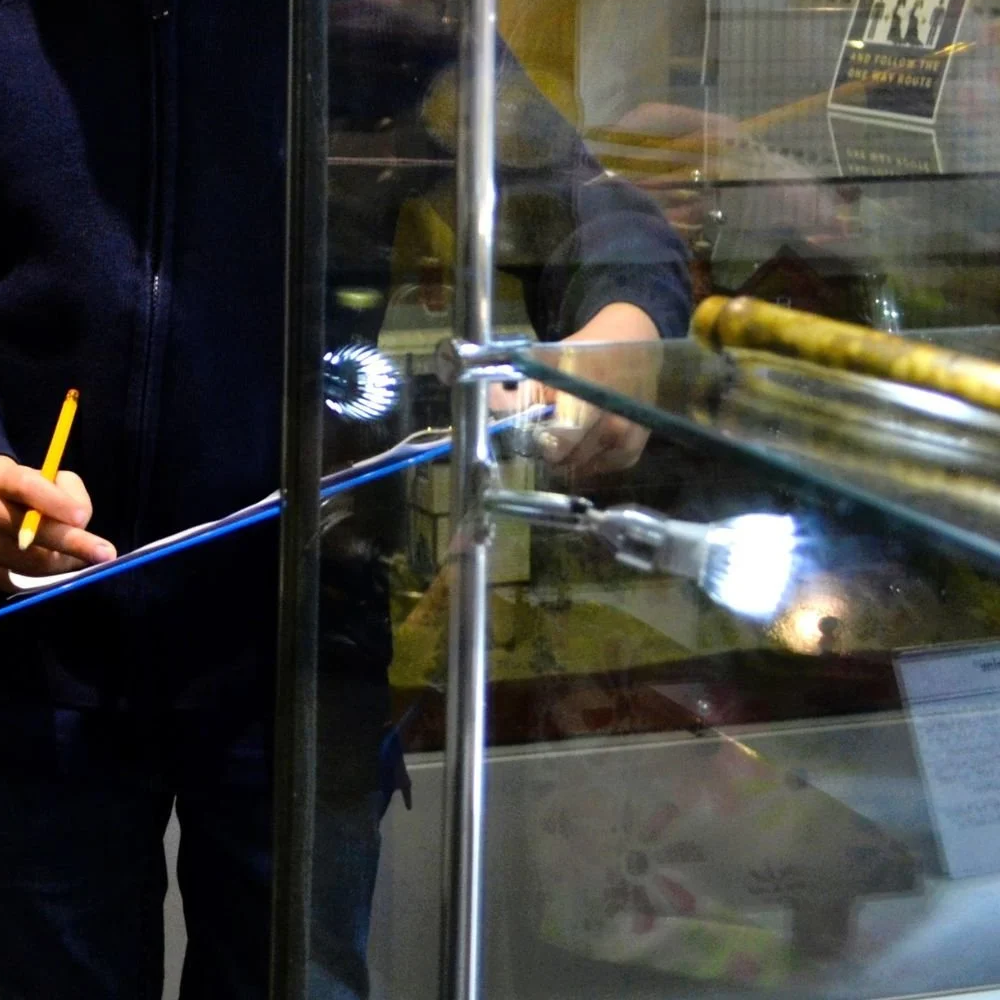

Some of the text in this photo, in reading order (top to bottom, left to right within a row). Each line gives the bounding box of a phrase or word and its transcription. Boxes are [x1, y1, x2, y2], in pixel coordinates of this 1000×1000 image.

[874, 54, 916, 69] FOLLOW
[919, 58, 941, 72] THE
[871, 71, 896, 83] WAY
[896, 74, 933, 89] ROUTE
